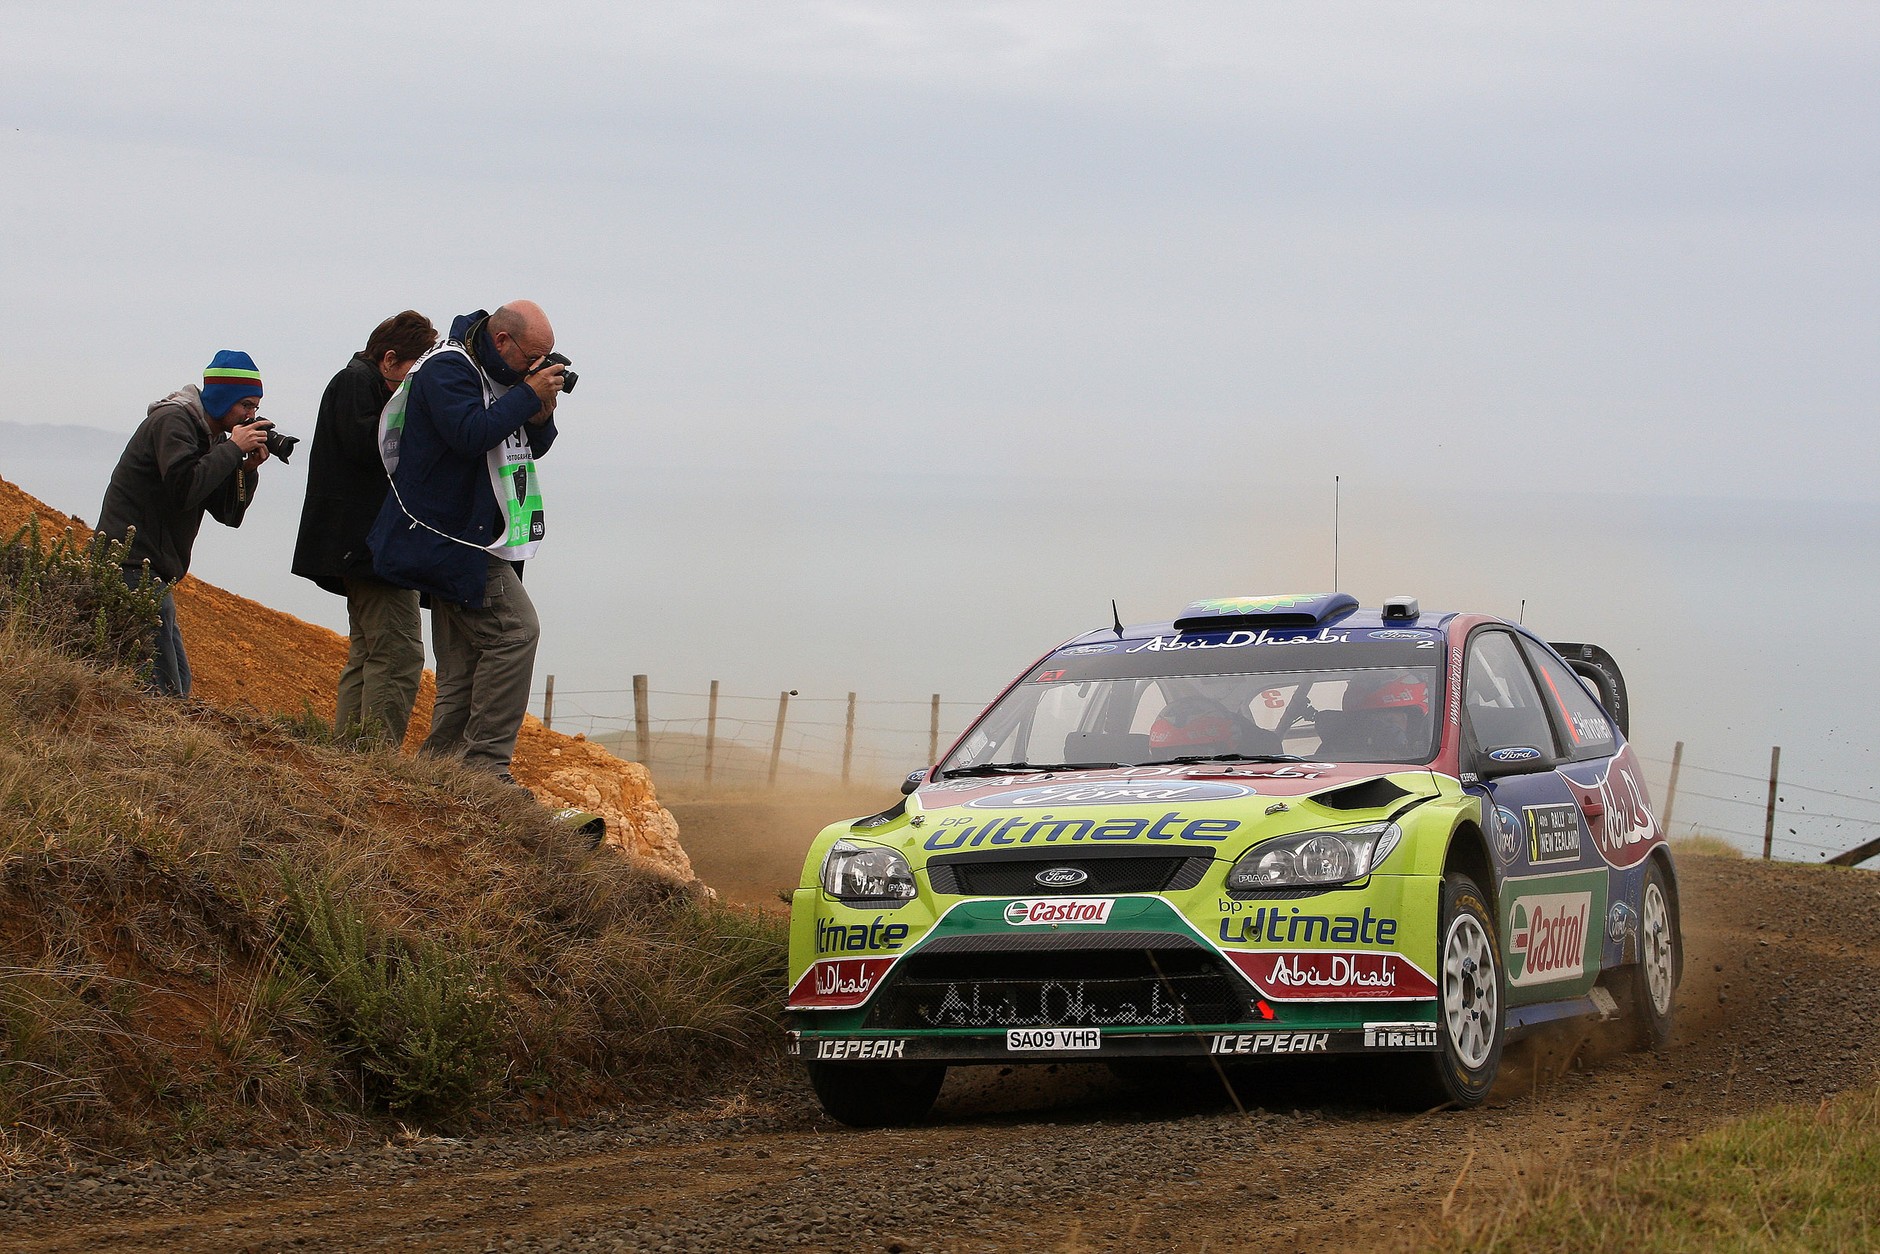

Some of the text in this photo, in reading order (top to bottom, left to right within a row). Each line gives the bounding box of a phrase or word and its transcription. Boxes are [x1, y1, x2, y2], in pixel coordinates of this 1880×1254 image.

[1416, 640, 1435, 649] 2
[1499, 750, 1532, 760] Ford
[1012, 783, 1202, 805] Ford
[940, 816, 973, 827] bp
[1550, 811, 1566, 828] RALLY
[923, 812, 1242, 850] ultimate
[1494, 811, 1516, 853] Ford
[1527, 809, 1538, 861] 3
[1541, 830, 1579, 853] NEW ZEALAND
[1046, 868, 1075, 881] Ford
[1238, 875, 1270, 883] PIAA
[1029, 902, 1106, 921] Castrol
[1219, 898, 1243, 915] bp
[815, 915, 909, 954] ltimate
[1219, 906, 1397, 945] ultimate
[1526, 903, 1585, 974] Castrol
[1010, 1031, 1098, 1048] SA09 VHR
[1210, 1033, 1330, 1054] ICEPEAK
[1363, 1022, 1438, 1047] PIRELLI
[816, 1040, 905, 1058] ICEPEAK
